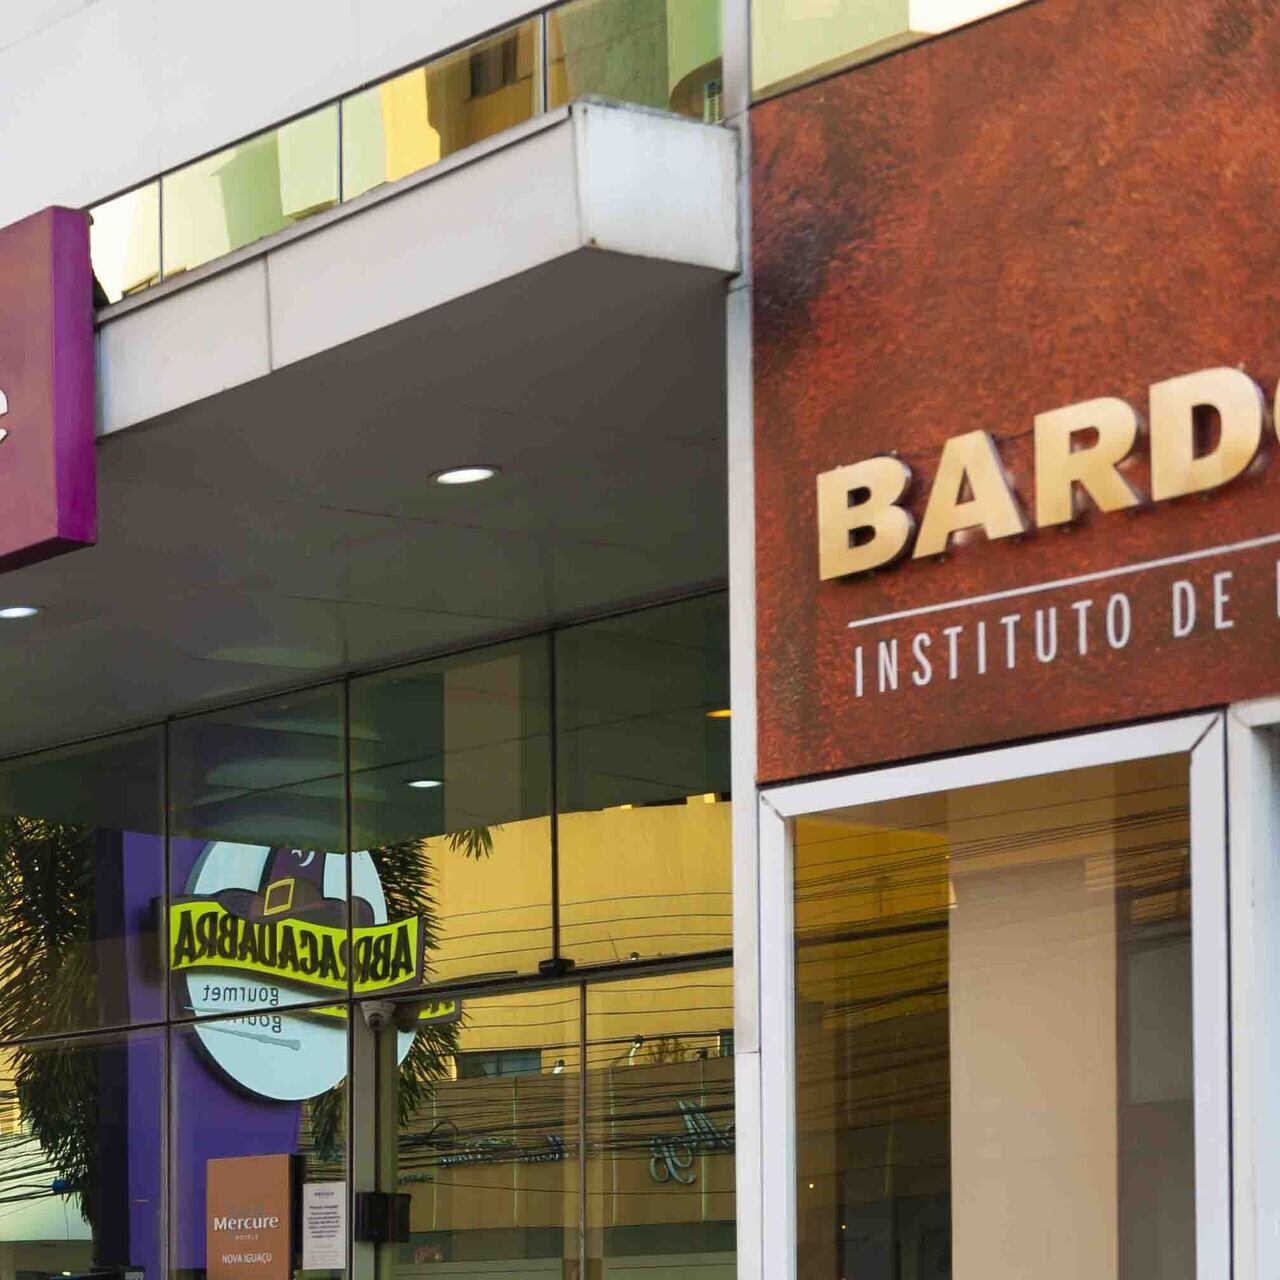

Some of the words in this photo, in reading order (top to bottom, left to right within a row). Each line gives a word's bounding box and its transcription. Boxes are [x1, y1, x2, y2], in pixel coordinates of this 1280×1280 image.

[816, 365, 1280, 582] BARD
[854, 592, 1131, 698] INSTITUTO
[1171, 571, 1235, 638] DE
[214, 1216, 279, 1231] Mercure
[222, 1254, 242, 1265] NOVA
[244, 1252, 272, 1265] IGUAÇU
